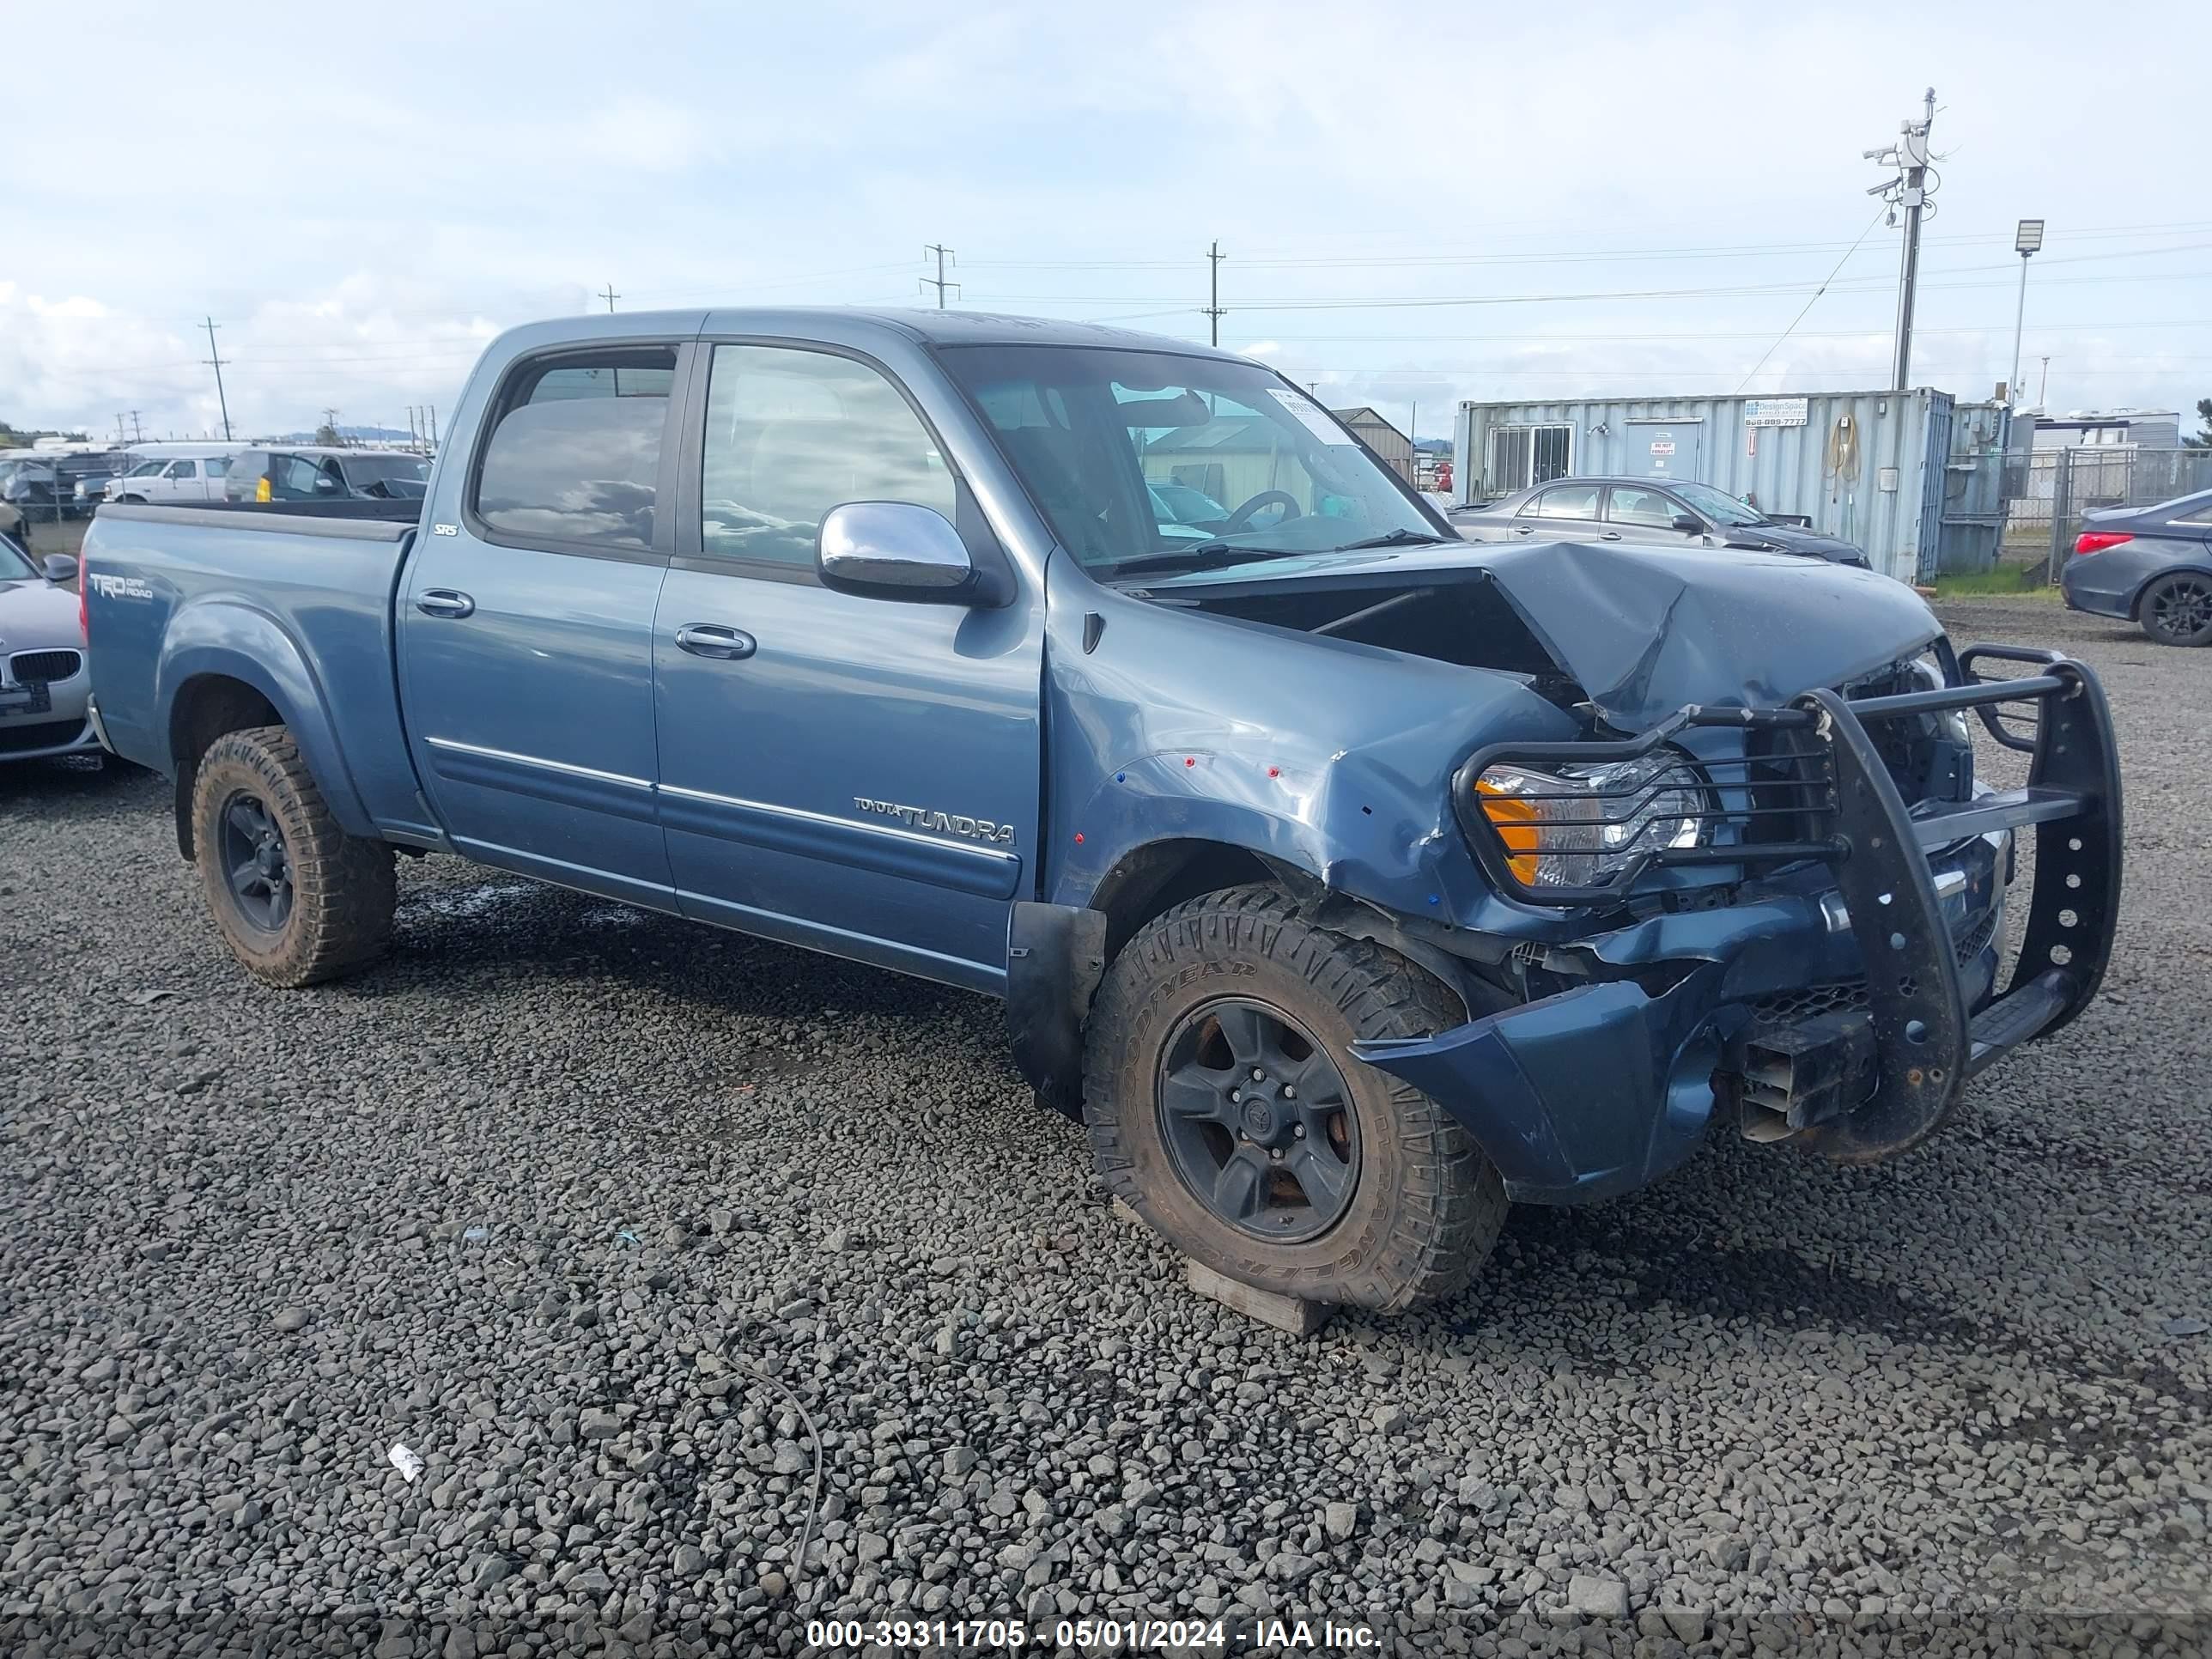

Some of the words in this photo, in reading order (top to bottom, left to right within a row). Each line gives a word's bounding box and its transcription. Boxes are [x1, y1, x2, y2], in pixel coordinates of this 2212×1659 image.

[1759, 401, 1807, 411] DesignSpace
[89, 573, 125, 599] TRD
[126, 577, 144, 586] OFF
[126, 586, 153, 599] ROAD
[852, 796, 902, 817] TOYOTA
[895, 804, 1018, 847] TUNDRA
